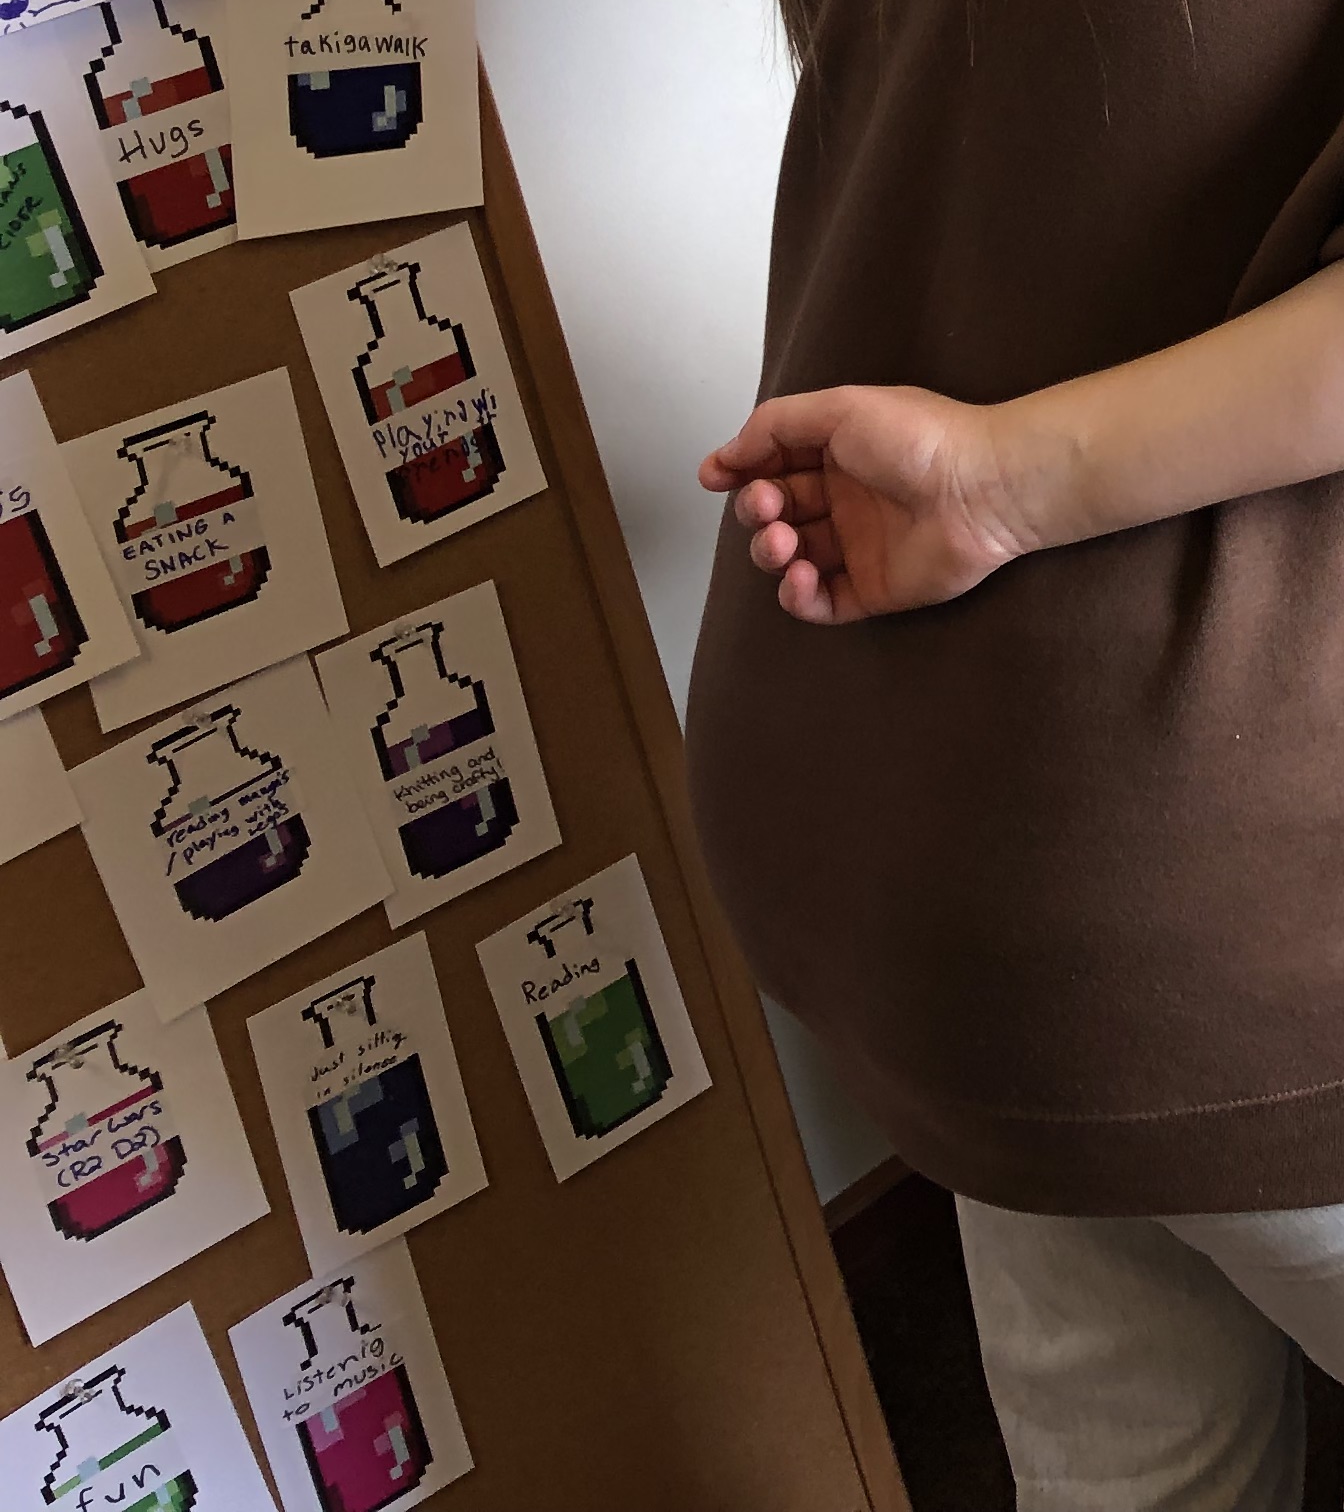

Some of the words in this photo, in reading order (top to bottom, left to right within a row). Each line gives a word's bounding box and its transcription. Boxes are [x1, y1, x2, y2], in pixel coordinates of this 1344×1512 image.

[118, 117, 205, 164] Hugs
[122, 519, 209, 561] EATING
[223, 512, 236, 526] A
[145, 538, 230, 581] SNACK
[394, 766, 464, 802] Knitting
[468, 746, 496, 769] and
[406, 790, 450, 814] being
[521, 957, 601, 1005] Reading
[282, 1402, 311, 1422] to
[333, 1352, 405, 1397] music
[76, 1464, 161, 1512] fun
